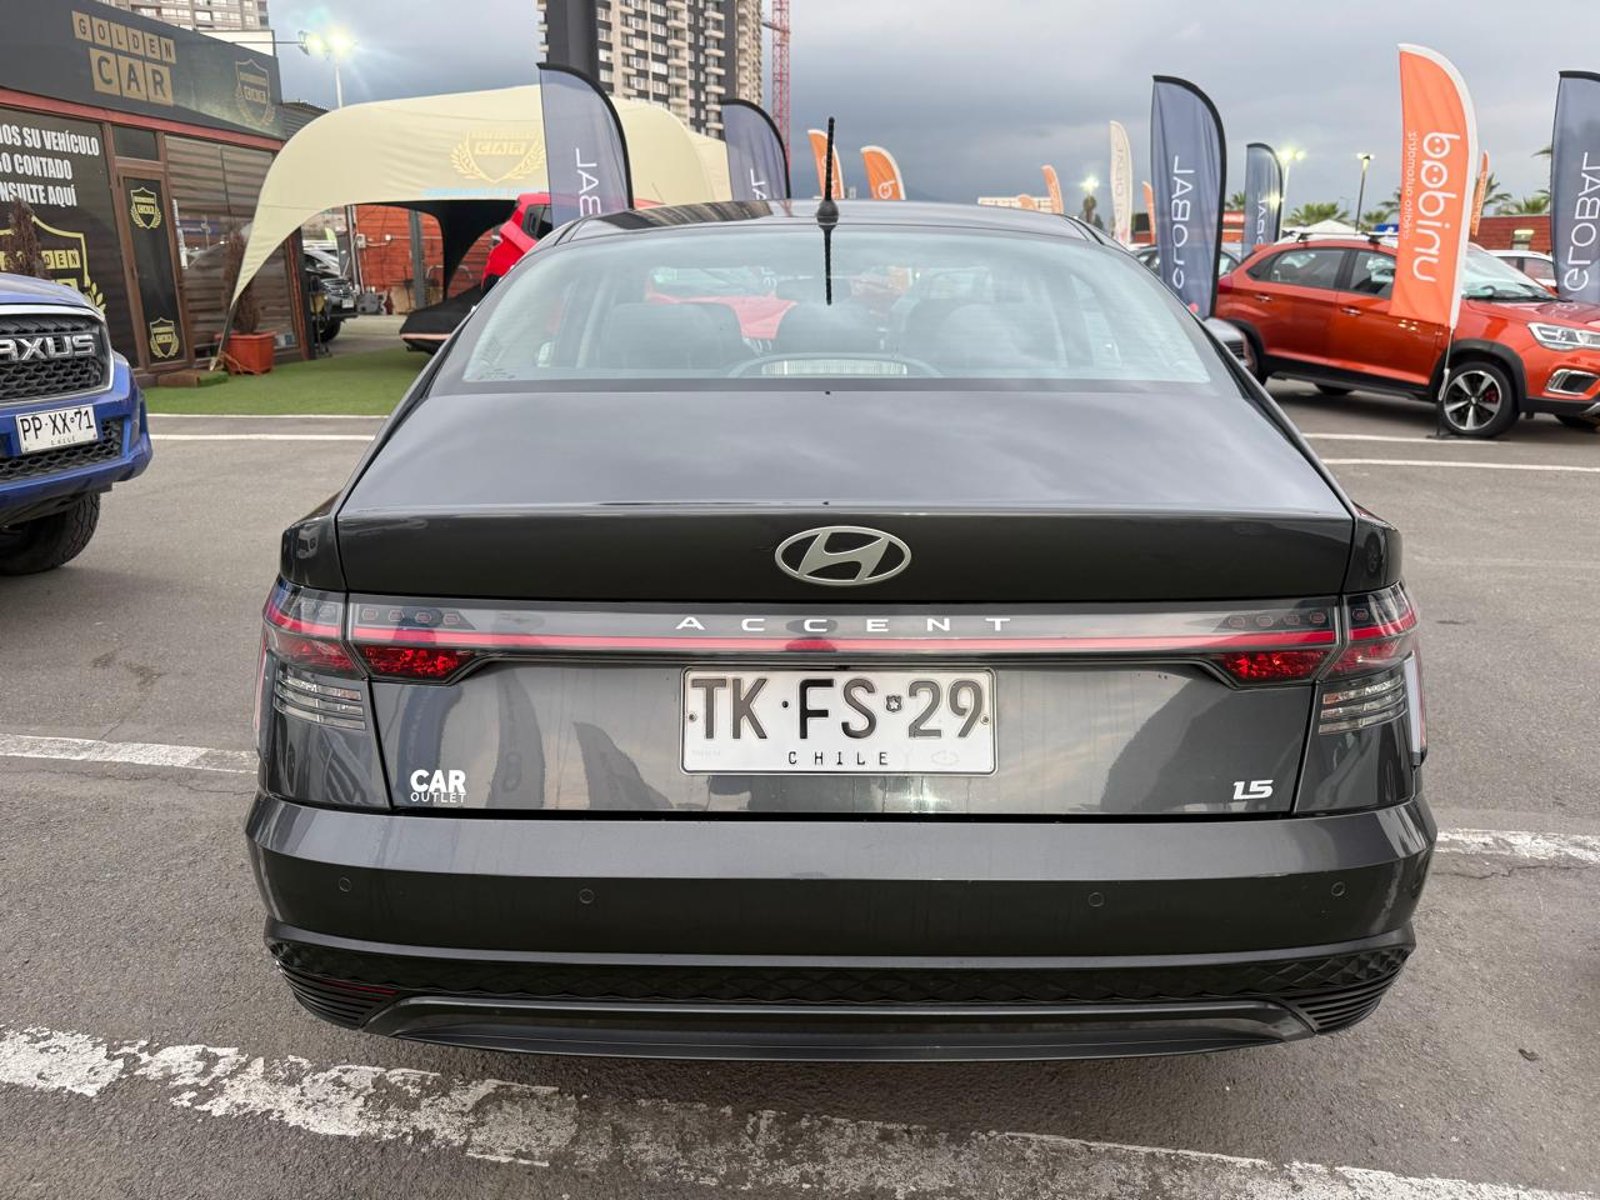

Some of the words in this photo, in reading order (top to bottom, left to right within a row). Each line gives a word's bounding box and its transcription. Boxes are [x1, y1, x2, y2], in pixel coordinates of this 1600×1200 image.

[77, 17, 173, 59] GOLDEN
[96, 55, 168, 98] CAR
[0, 124, 21, 146] OS
[22, 127, 41, 149] SU
[41, 130, 100, 156] VEHÍCULO
[13, 153, 73, 180] CONTADO
[47, 184, 78, 208] AQUÍ
[675, 616, 1011, 632] ACCENT
[787, 750, 890, 766] CHILE
[410, 768, 467, 793] CAR
[410, 791, 467, 803] OUTLET
